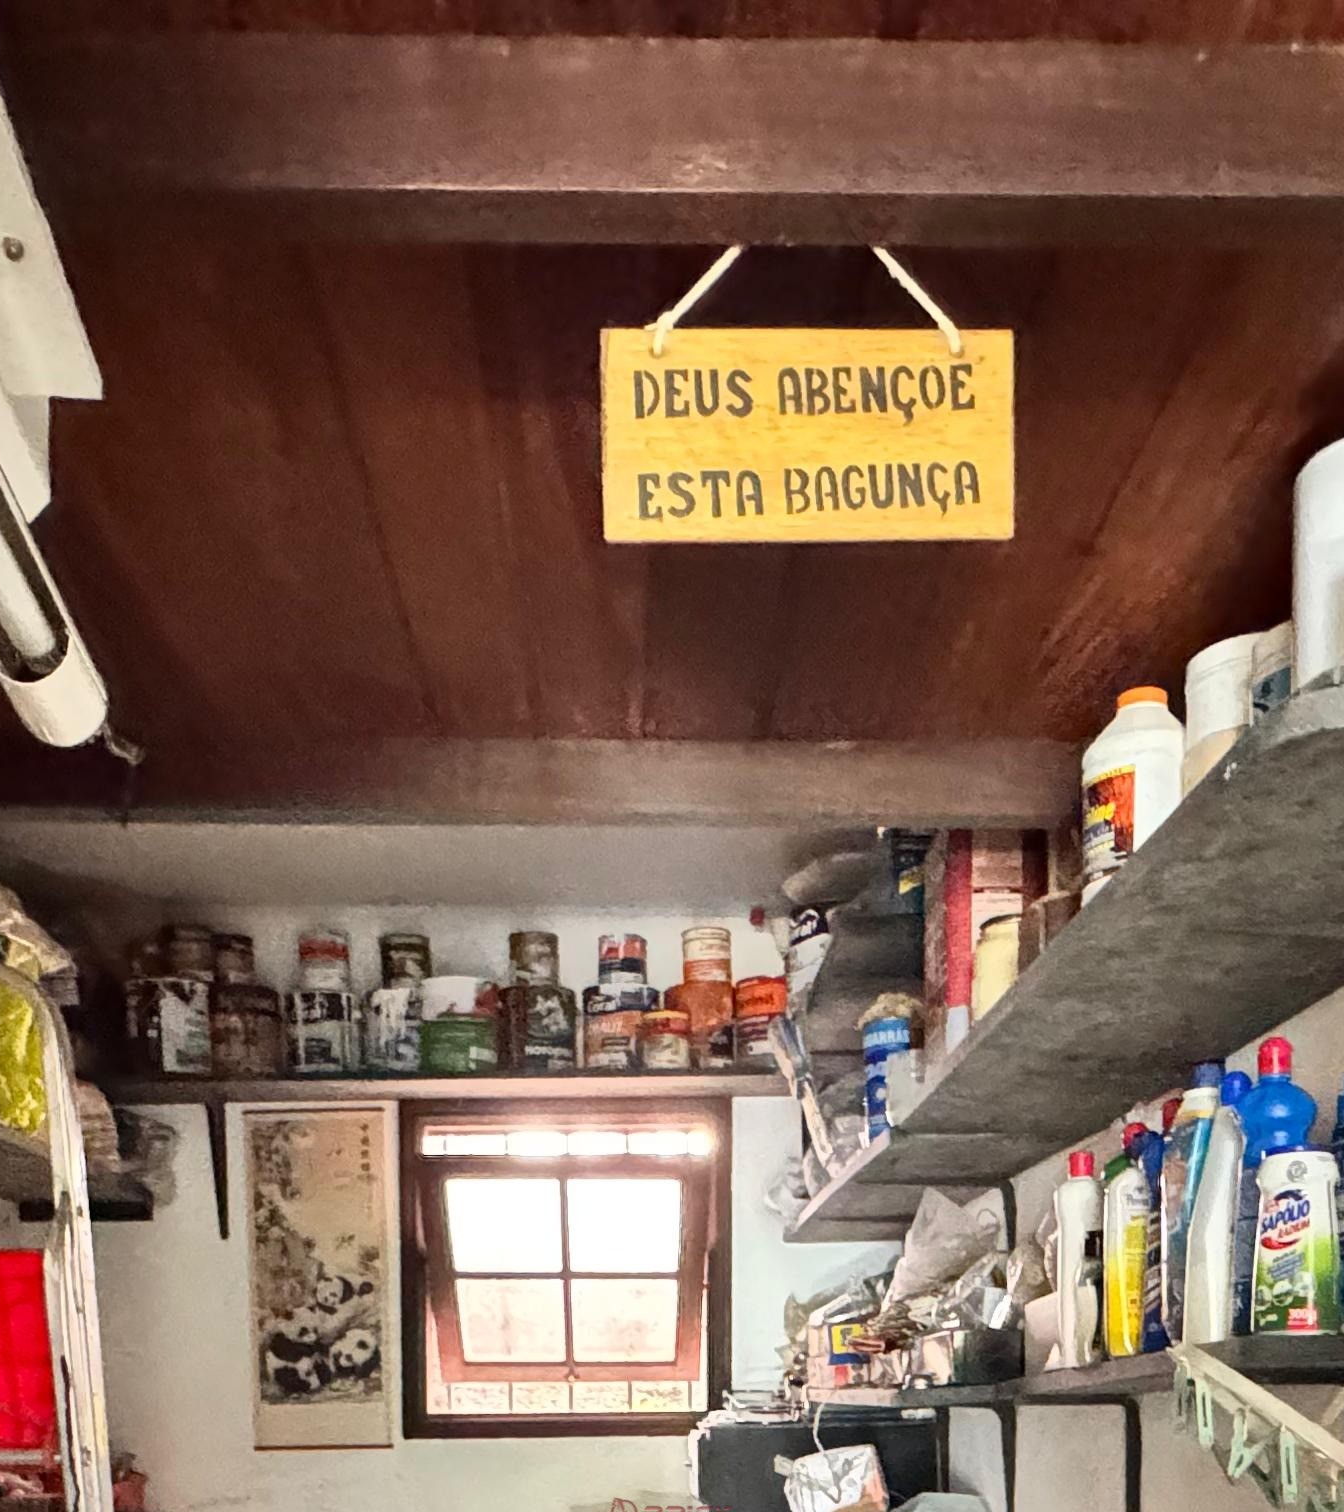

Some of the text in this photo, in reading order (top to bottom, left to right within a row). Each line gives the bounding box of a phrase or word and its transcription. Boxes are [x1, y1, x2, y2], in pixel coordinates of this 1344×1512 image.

[633, 364, 976, 425] DEUS ABENÇOE
[637, 461, 981, 521] ESTA BAGUNÇA
[1260, 1199, 1311, 1235] SAPÓLIO
